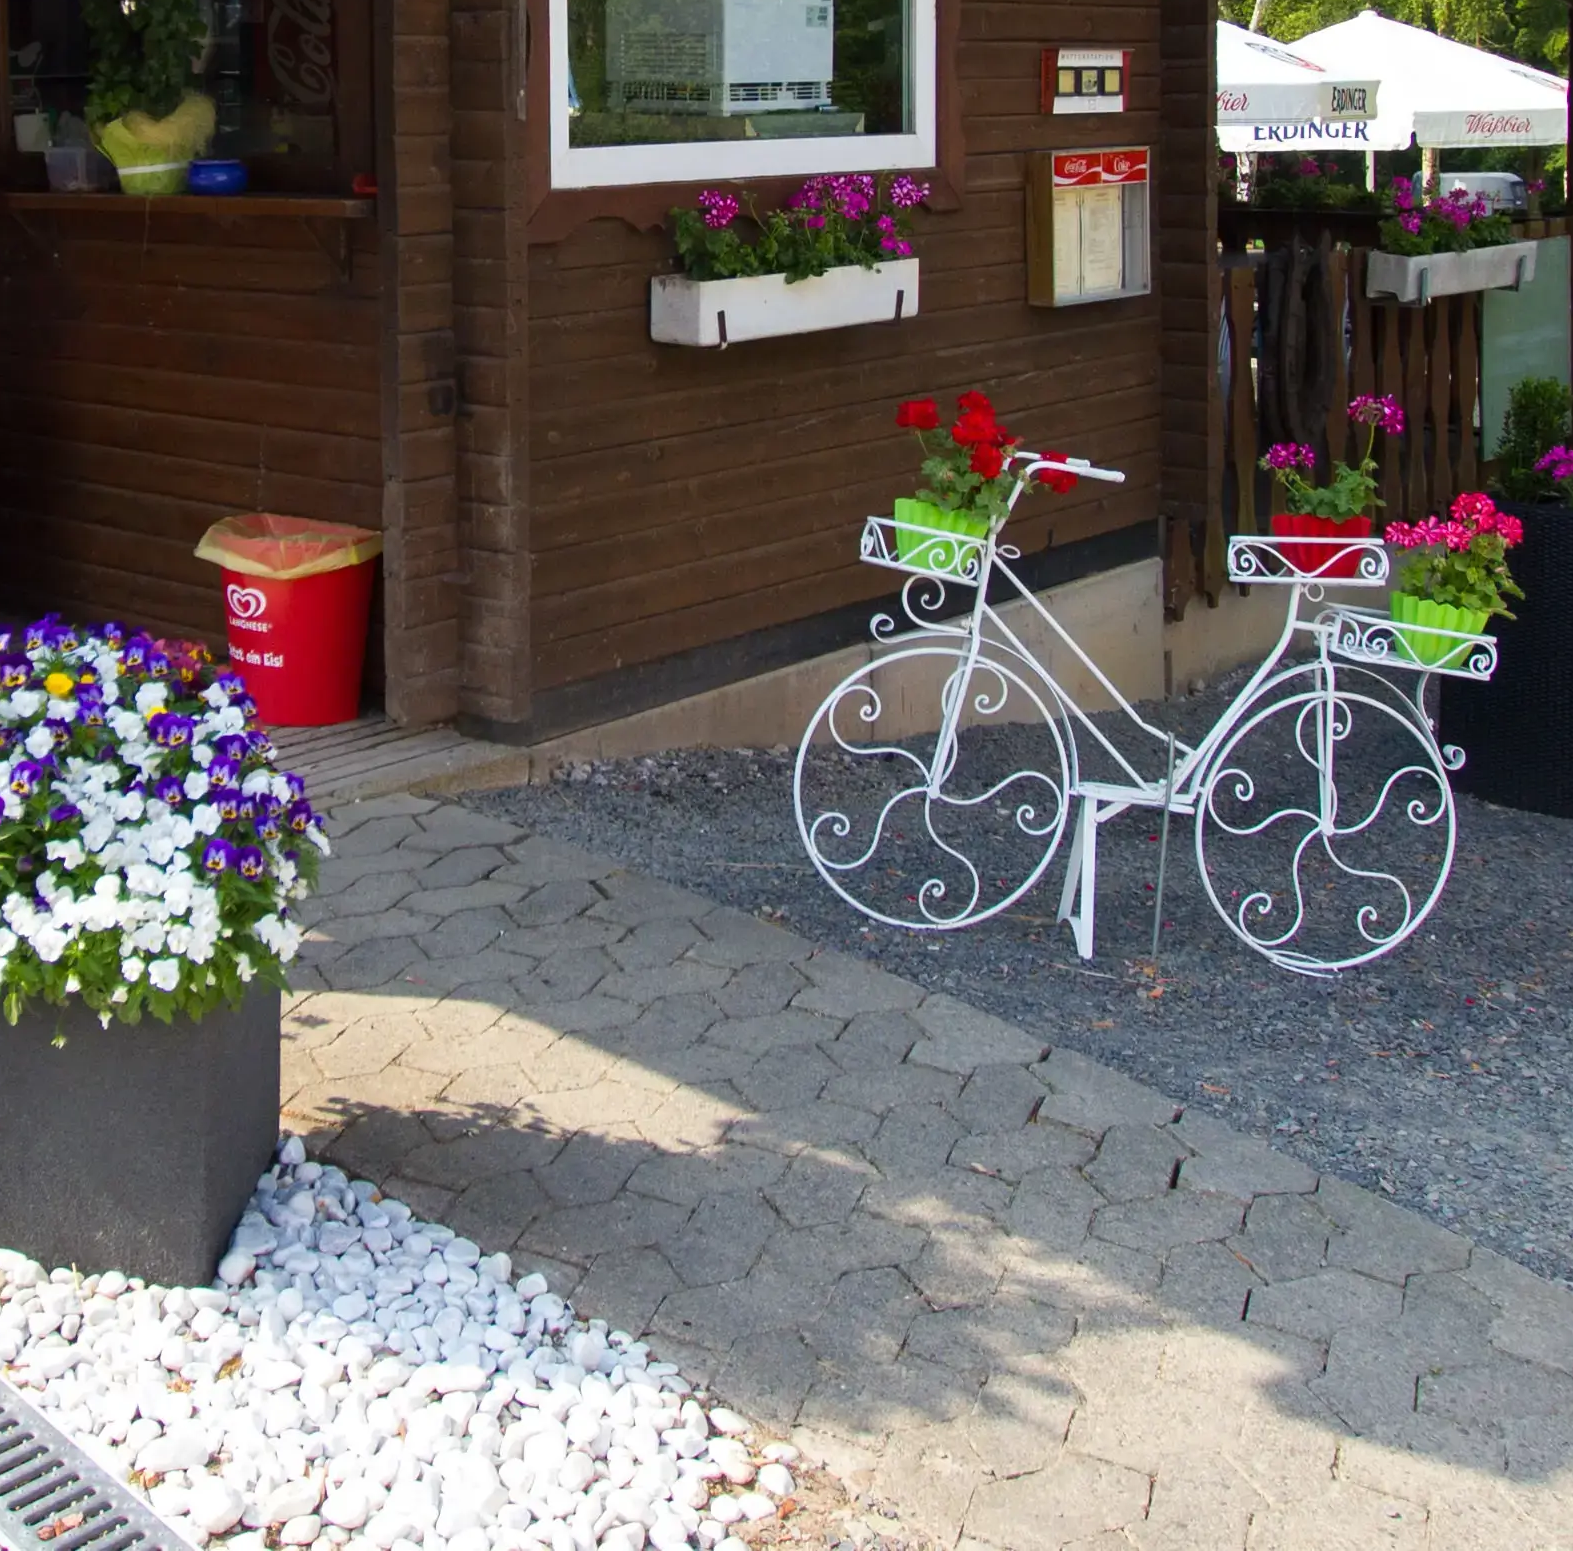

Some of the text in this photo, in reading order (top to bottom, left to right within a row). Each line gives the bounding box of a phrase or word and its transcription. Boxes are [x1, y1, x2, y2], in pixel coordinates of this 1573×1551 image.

[1331, 86, 1367, 114] ERDINGER
[1253, 121, 1370, 142] ERDINGER
[1465, 113, 1532, 138] Weißbier
